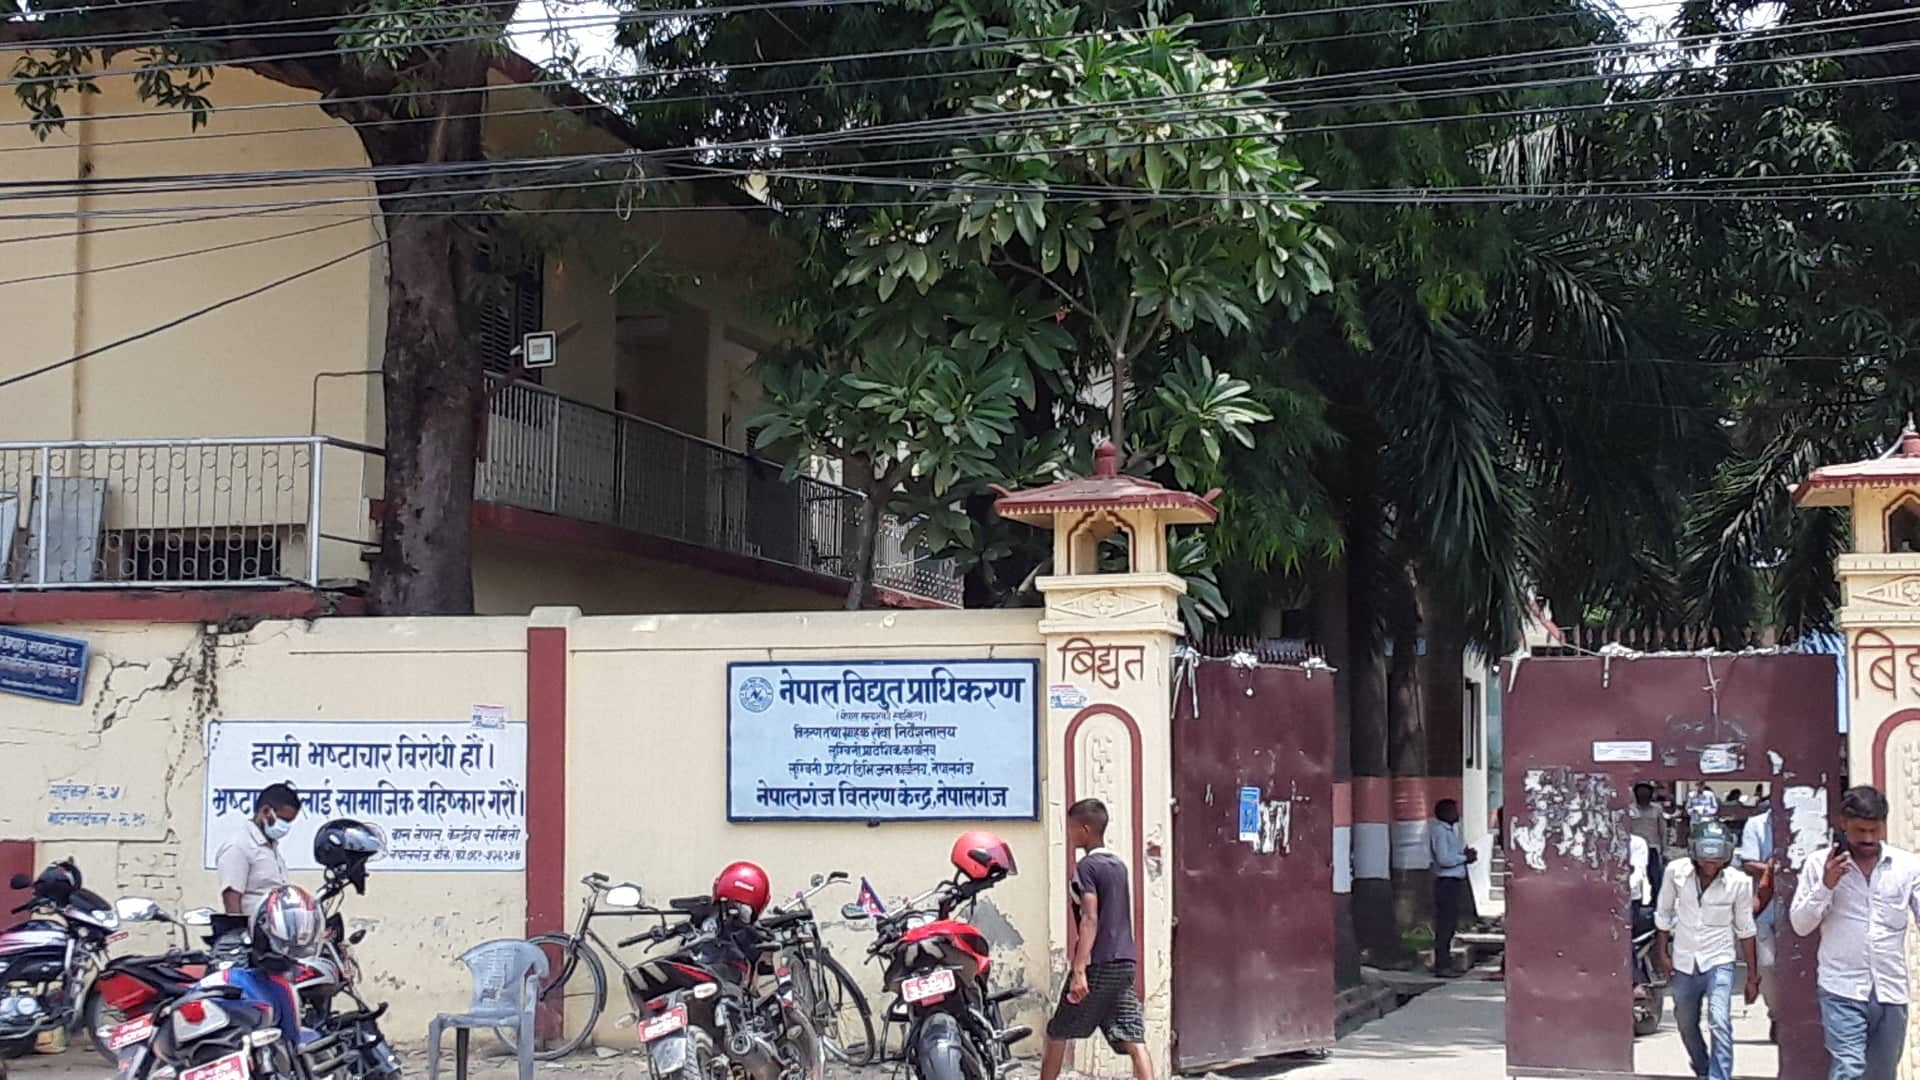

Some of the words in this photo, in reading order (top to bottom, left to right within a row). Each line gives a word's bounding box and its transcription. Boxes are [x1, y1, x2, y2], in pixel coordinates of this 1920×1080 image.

[779, 668, 841, 709] नेपाल
[842, 669, 904, 710] विद्युत
[905, 666, 1026, 710] प्राधिकरण
[251, 734, 301, 773] हामी
[336, 780, 414, 816] सामाजिक
[756, 780, 835, 810] नेपालगंज
[838, 781, 895, 811] वितरण
[936, 780, 1009, 810] नेपालगंज
